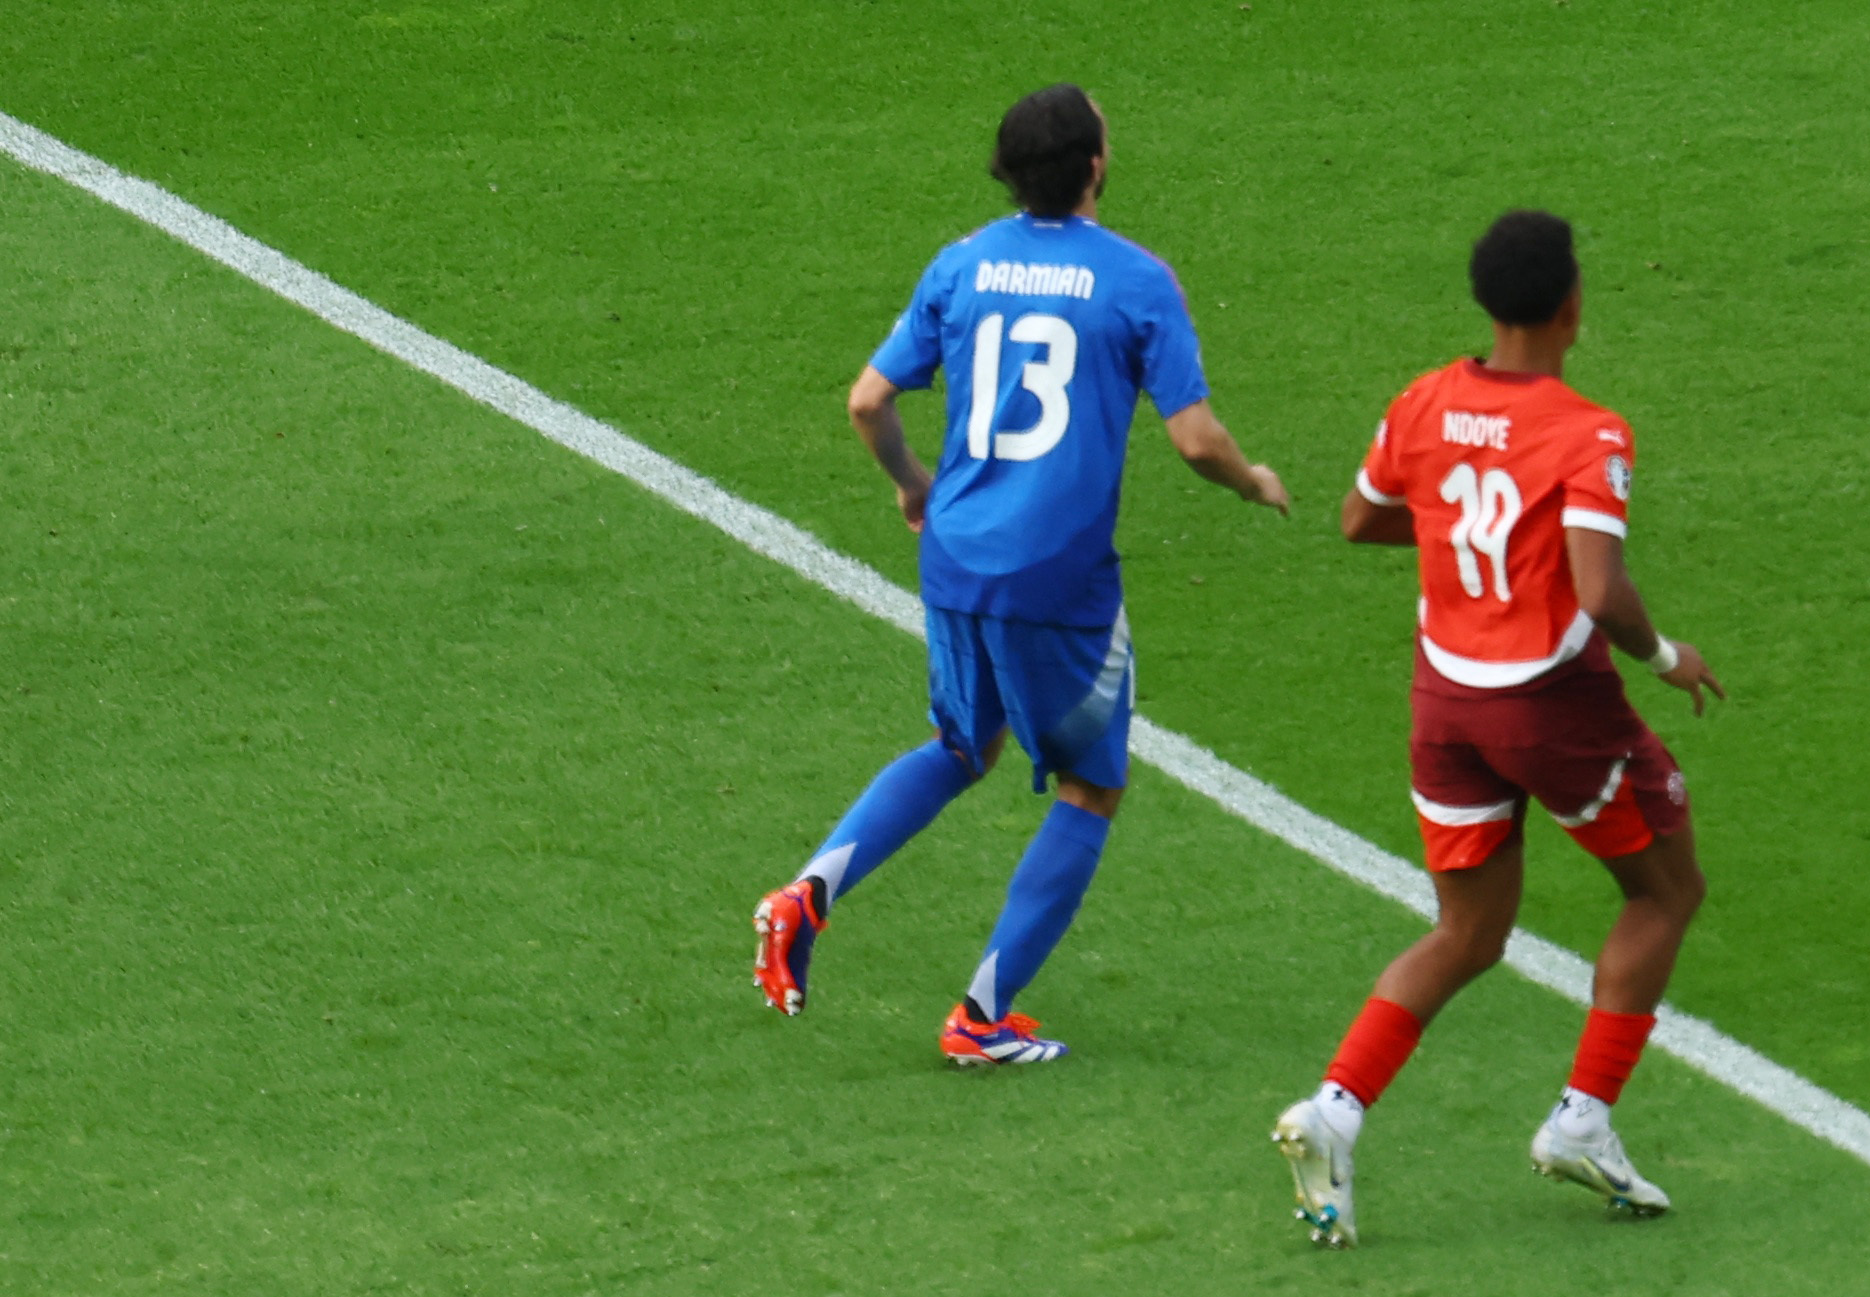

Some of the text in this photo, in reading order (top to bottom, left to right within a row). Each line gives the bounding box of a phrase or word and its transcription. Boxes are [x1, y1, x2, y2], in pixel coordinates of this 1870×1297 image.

[976, 260, 1094, 299] DARMIAN
[968, 313, 1077, 461] 13
[1442, 410, 1511, 450] NDOYE
[1440, 462, 1523, 602] 19
